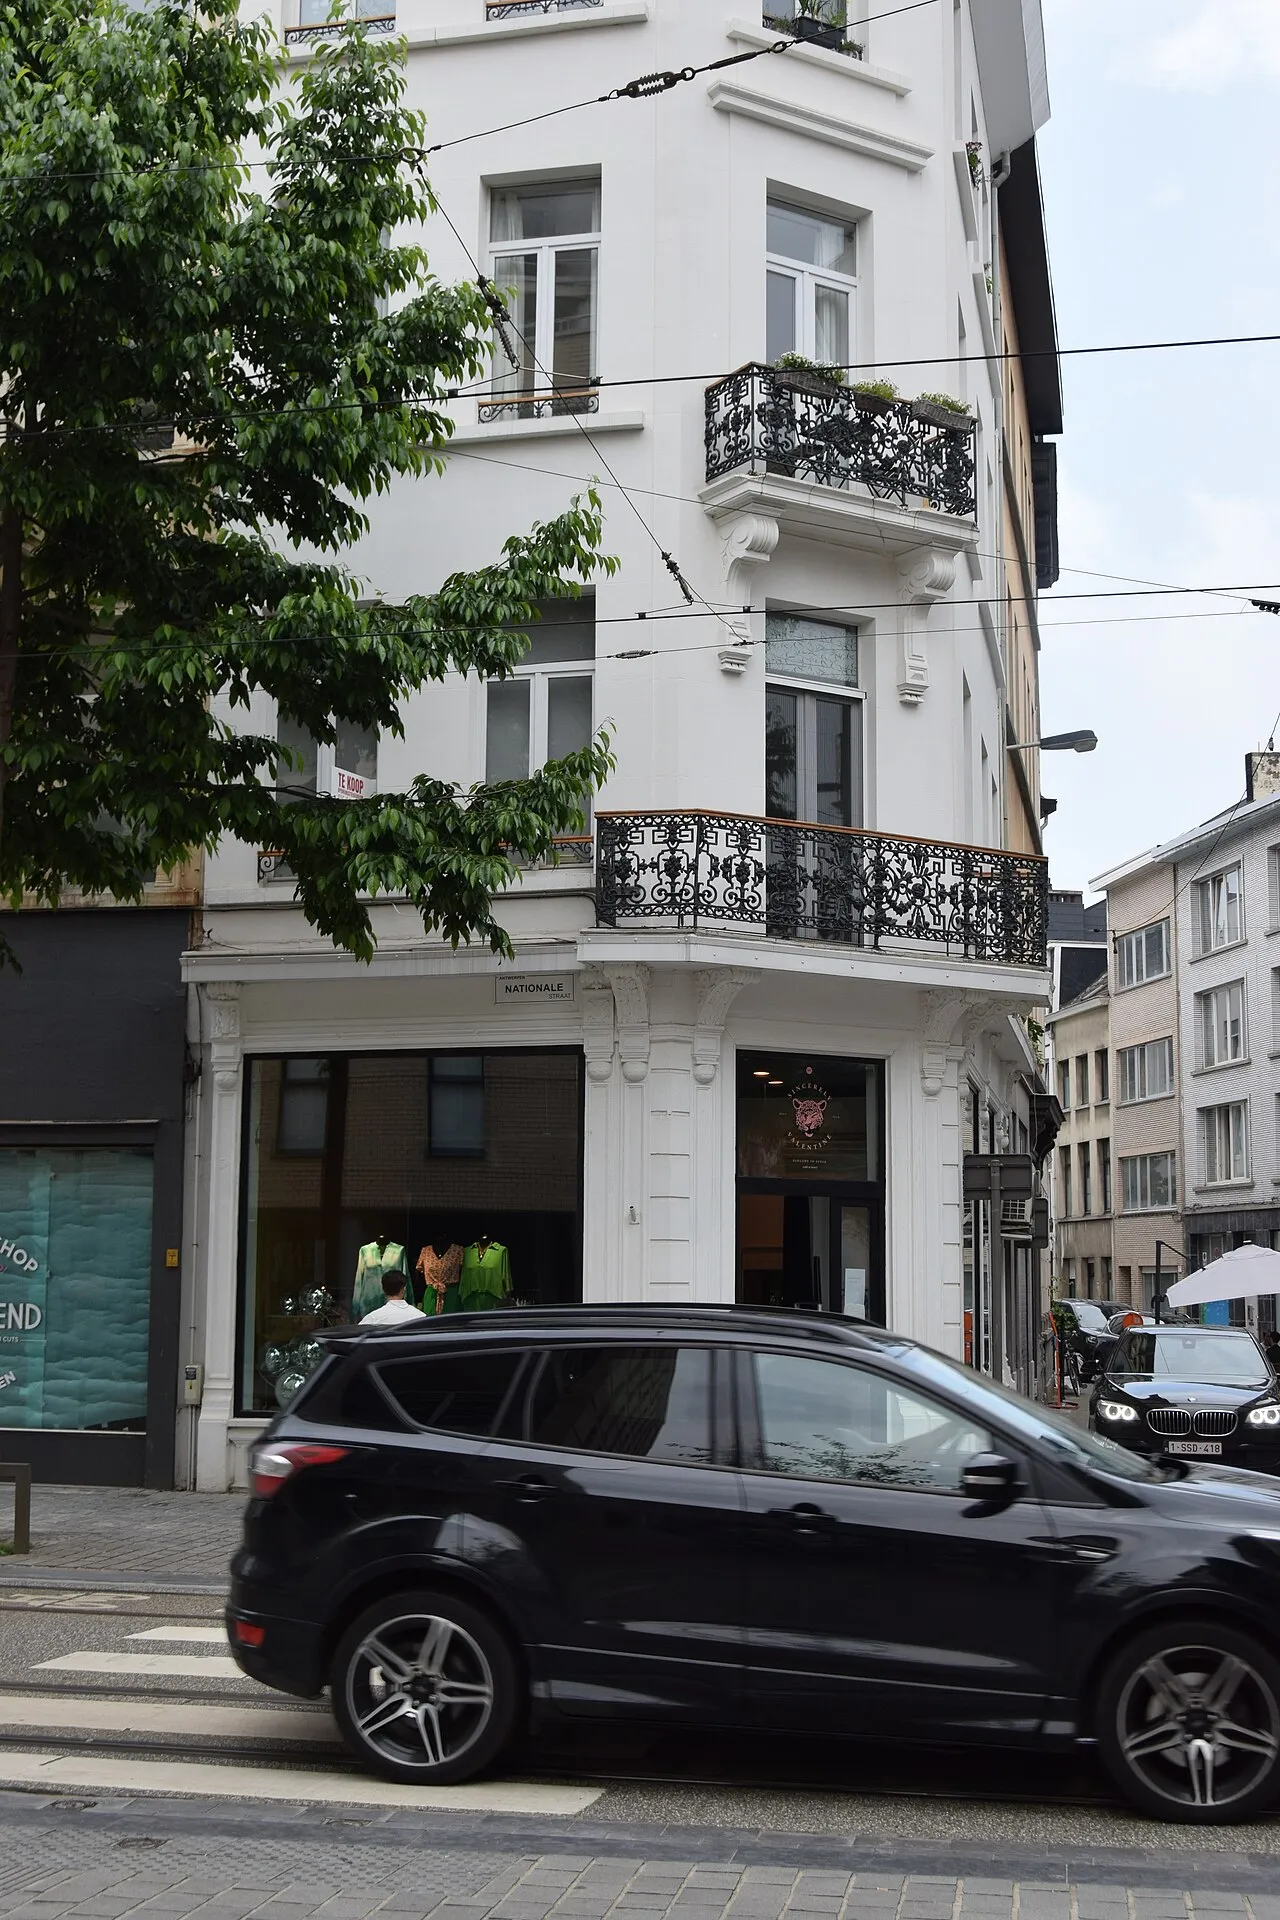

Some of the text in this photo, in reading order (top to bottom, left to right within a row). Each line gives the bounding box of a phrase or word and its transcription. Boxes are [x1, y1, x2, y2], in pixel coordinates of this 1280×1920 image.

[338, 772, 346, 788] TE
[346, 775, 364, 794] KOOP
[505, 983, 564, 993] NATIONALE
[788, 1083, 832, 1100] SINCERELY
[788, 1131, 832, 1150] VALENTINE
[1171, 1442, 1220, 1453] 1-SSD-418
